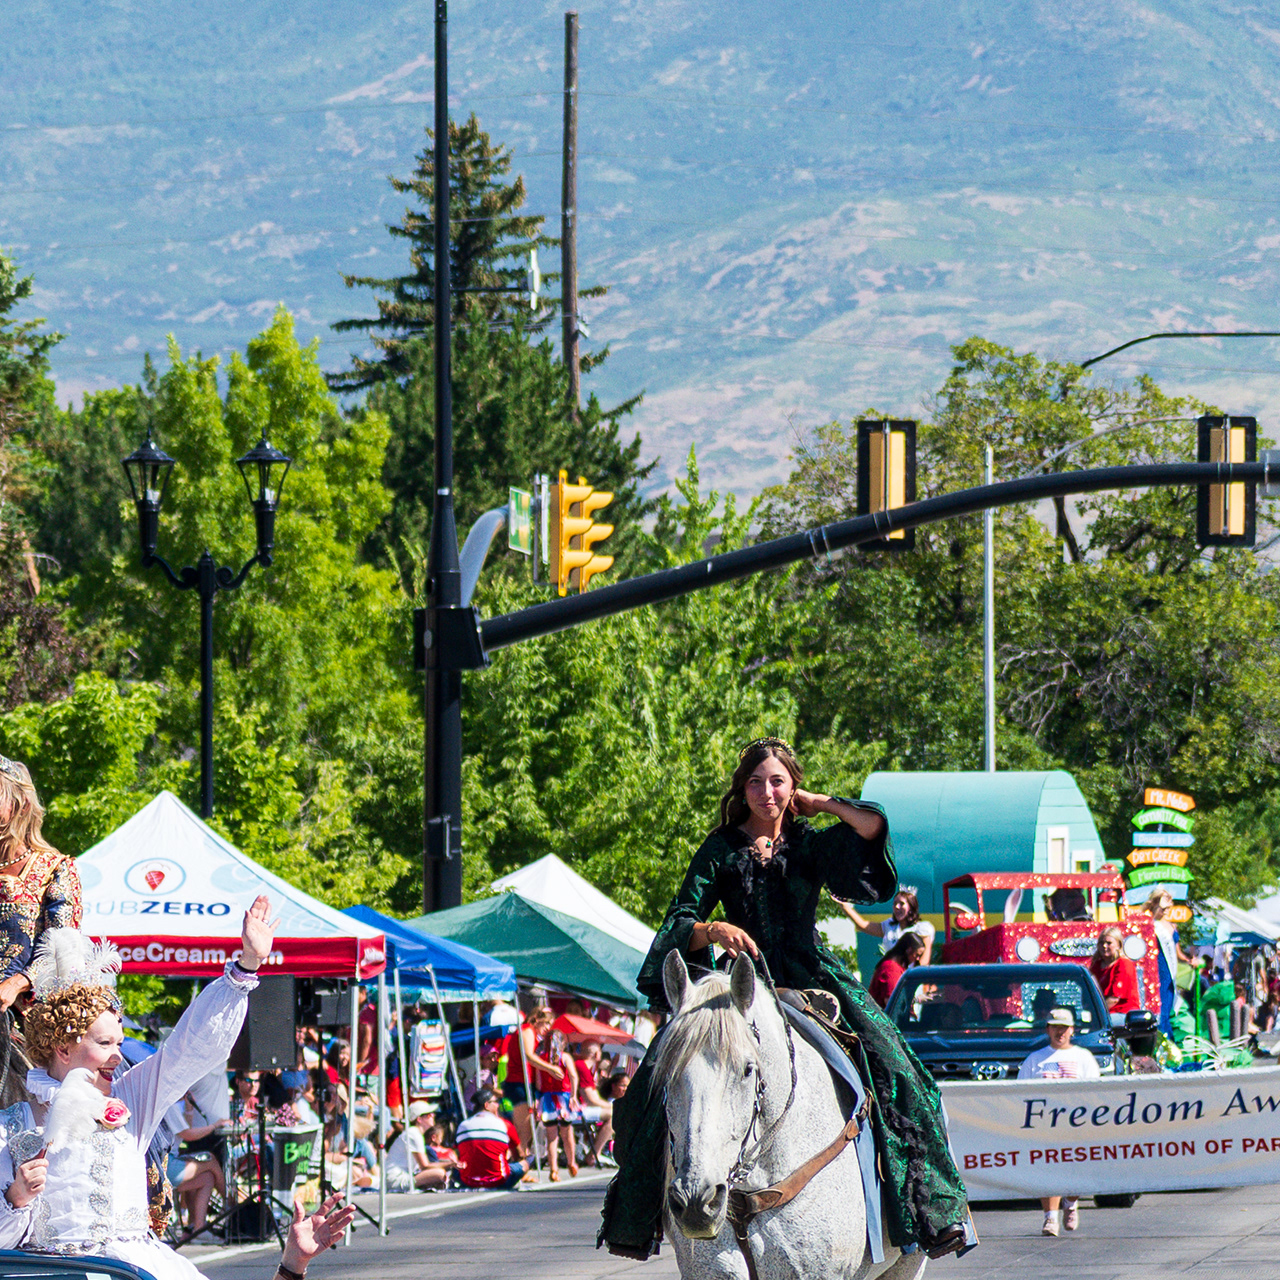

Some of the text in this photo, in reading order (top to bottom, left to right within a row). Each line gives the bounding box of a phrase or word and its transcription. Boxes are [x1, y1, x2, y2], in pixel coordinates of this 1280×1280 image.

[1166, 792, 1189, 811] Nebo
[1132, 849, 1181, 864] DRY CREEK
[1164, 908, 1187, 920] EACH
[1020, 1092, 1206, 1130] Freedom
[963, 1150, 1020, 1170] BEST
[1029, 1140, 1197, 1165] PRESENTATION
[1204, 1138, 1234, 1155] OF
